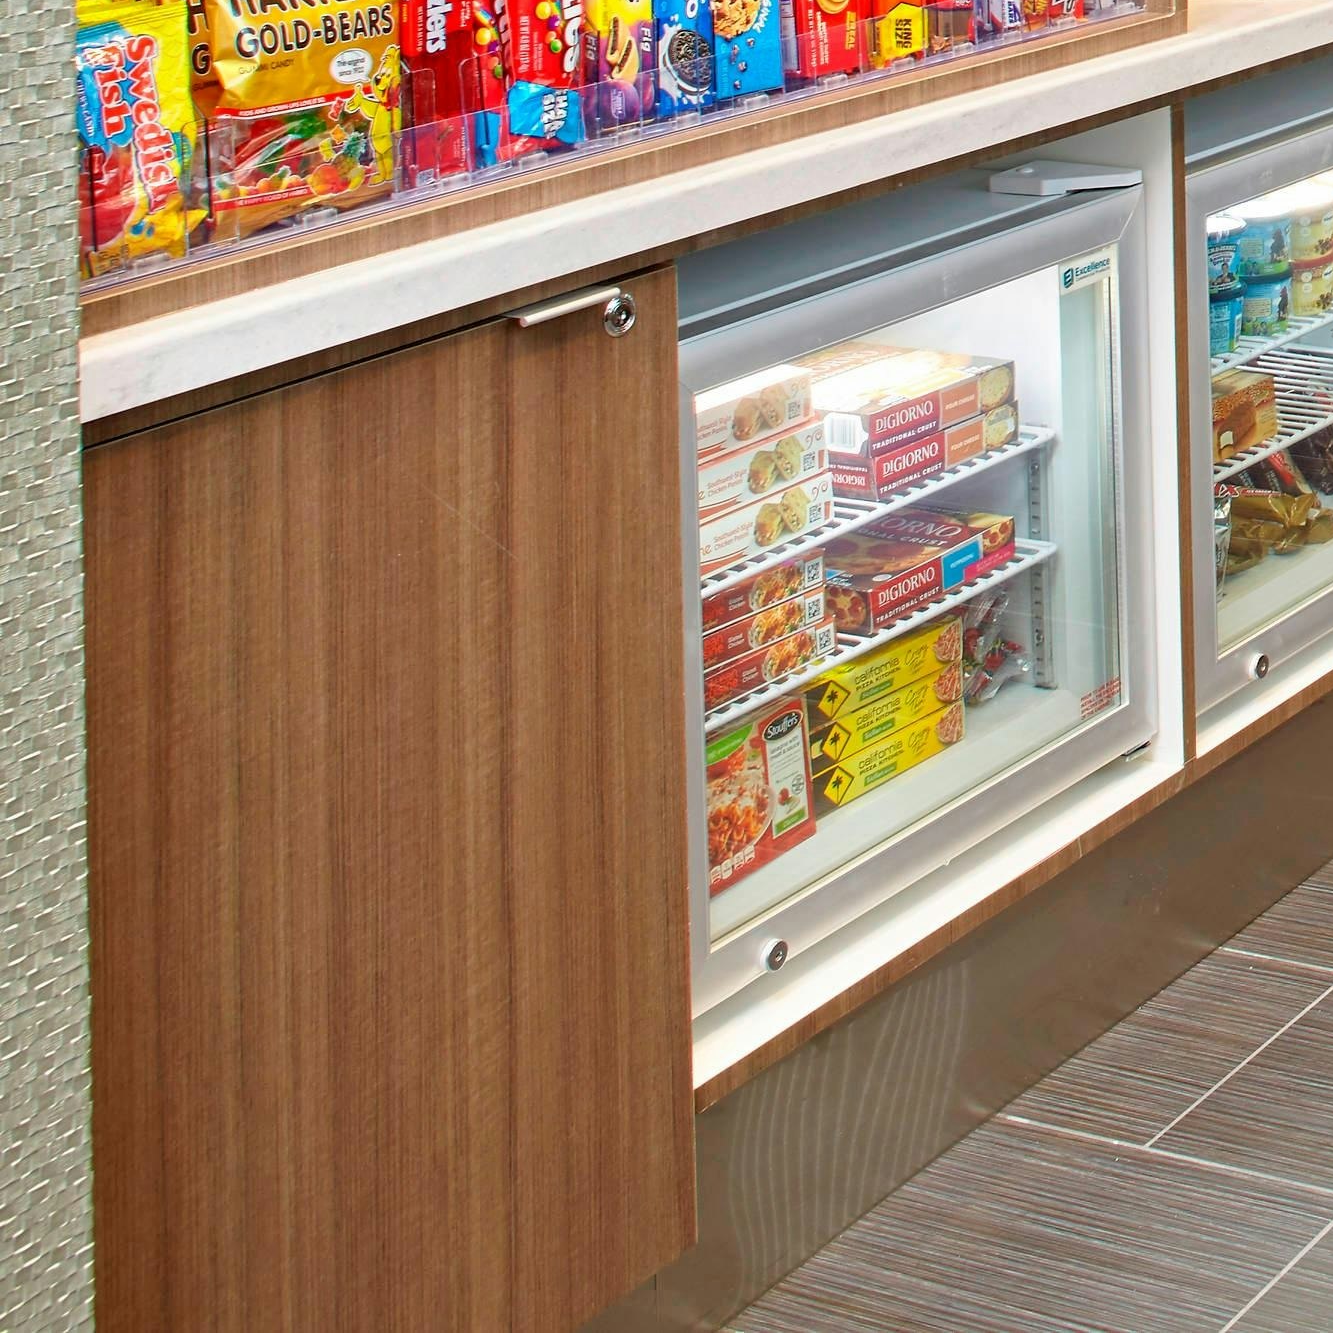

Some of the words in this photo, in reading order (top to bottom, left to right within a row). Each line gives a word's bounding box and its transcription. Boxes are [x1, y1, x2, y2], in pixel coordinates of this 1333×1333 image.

[235, 3, 394, 59] GOLD-BEARS
[641, 27, 652, 52] Fig
[895, 18, 904, 48] SIZE
[903, 18, 912, 49] KING
[270, 58, 294, 70] CANDY
[124, 34, 180, 215] Swedish
[1075, 257, 1111, 277] Excellence
[872, 428, 915, 450] TRADITIONAL
[915, 421, 937, 436] CRUST
[880, 473, 921, 495] TRADITIONAL
[921, 462, 943, 479] CRUST
[876, 598, 919, 623] TRADITIONAL
[919, 586, 940, 602] CRUST
[854, 657, 900, 684] california
[766, 713, 800, 739] Stouffer's
[856, 698, 901, 726] california
[858, 741, 904, 769] california
